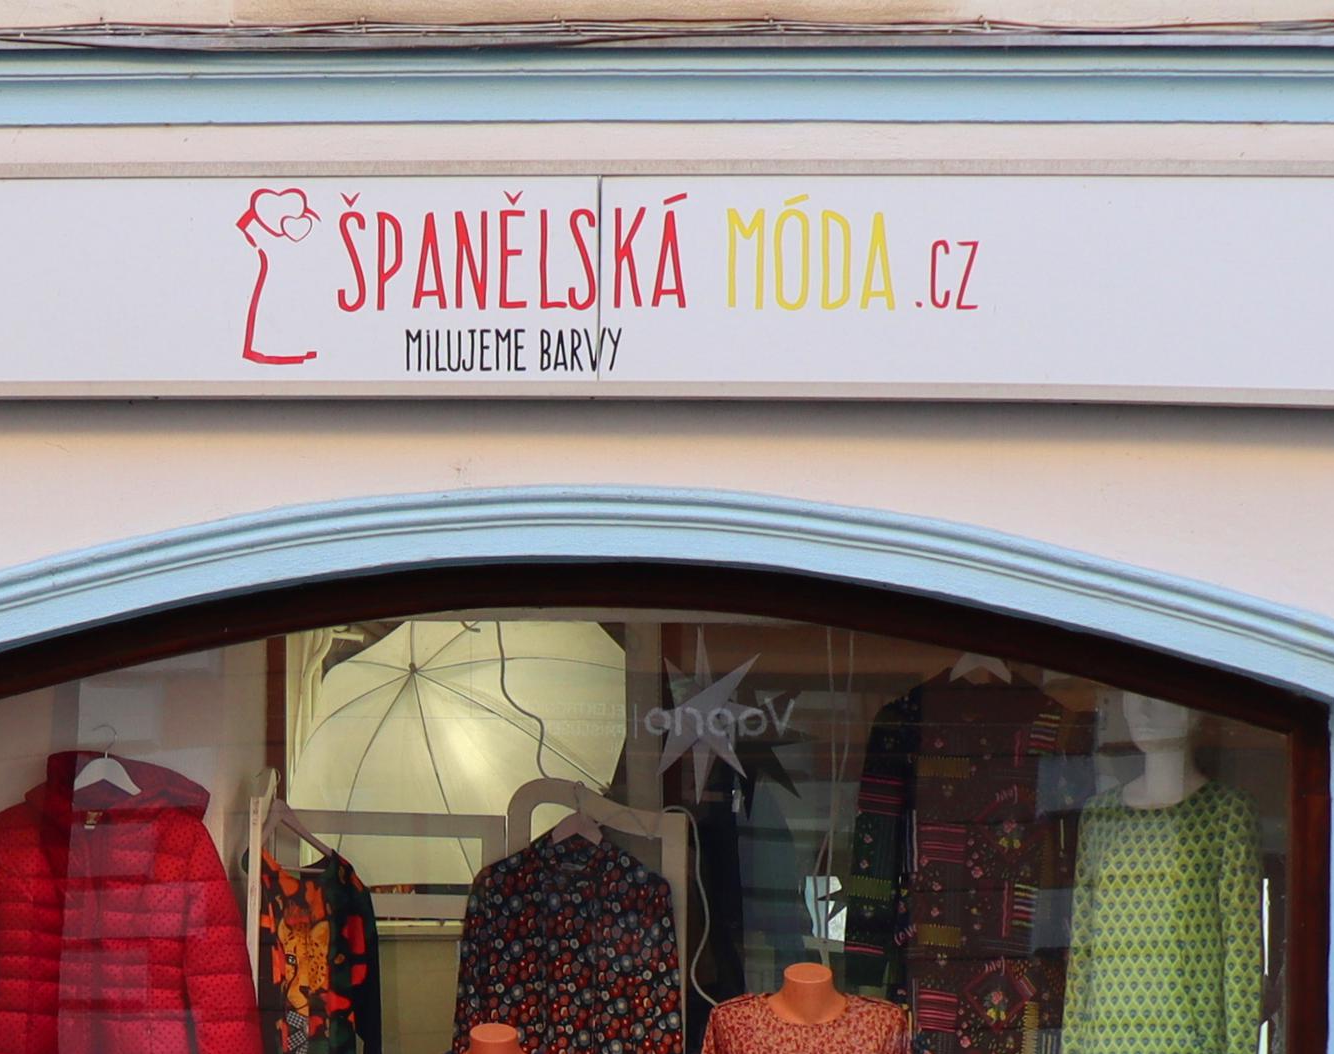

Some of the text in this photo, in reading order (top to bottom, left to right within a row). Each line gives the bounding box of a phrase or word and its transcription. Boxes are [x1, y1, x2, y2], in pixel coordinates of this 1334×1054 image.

[336, 188, 689, 313] ŠPANĚLSKÁ
[725, 192, 897, 312] MÓDA
[539, 327, 623, 373] BARVY
